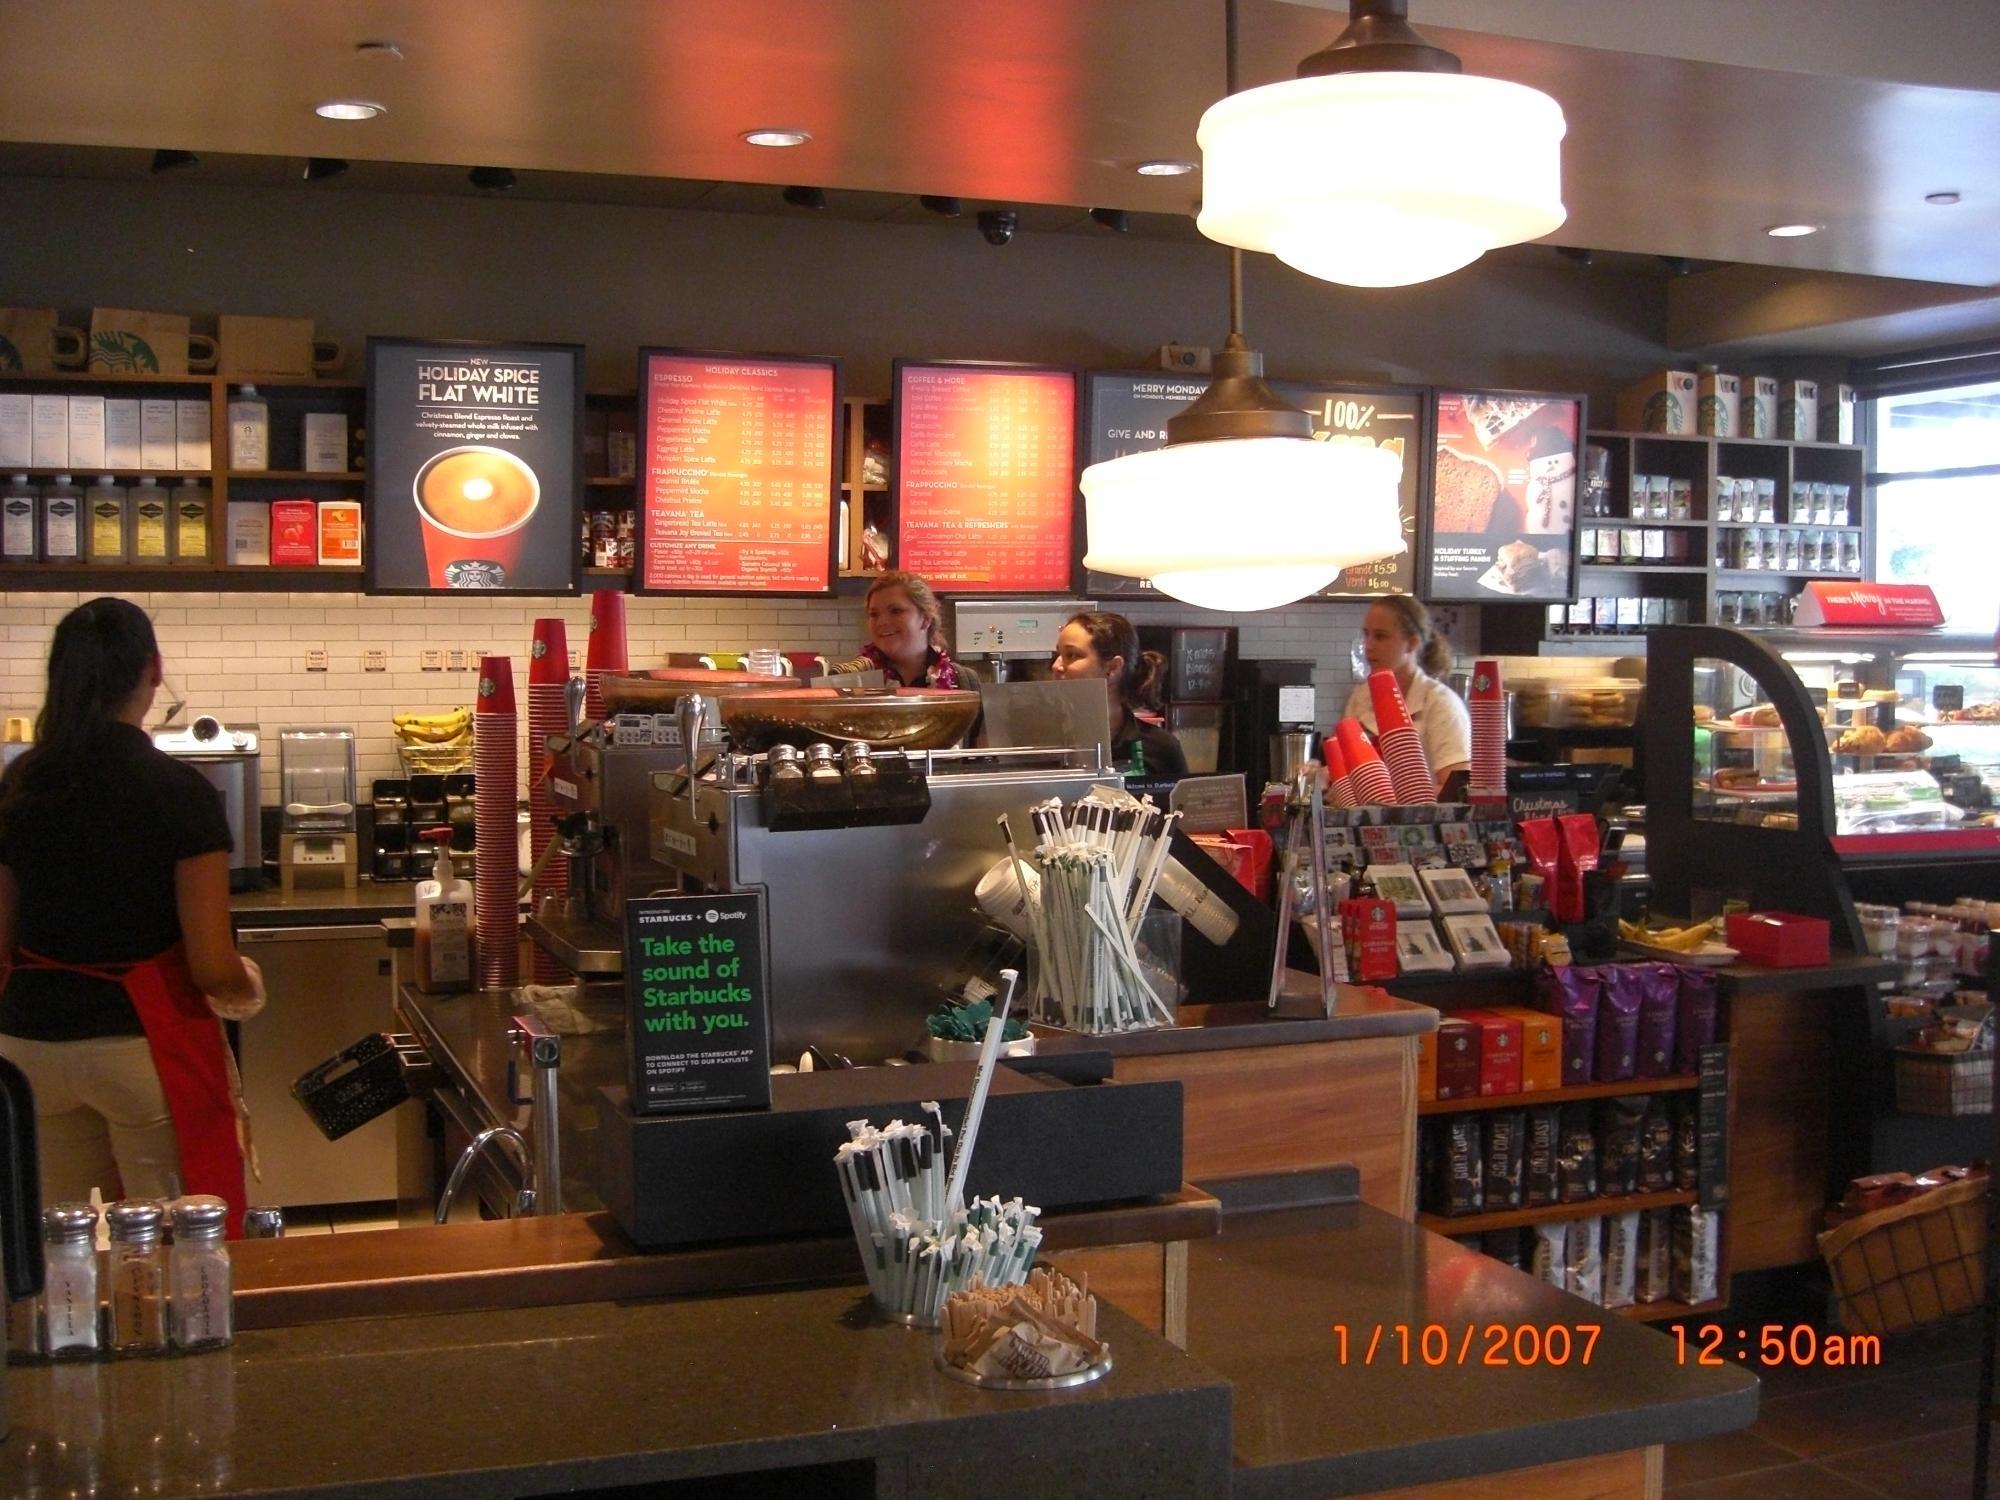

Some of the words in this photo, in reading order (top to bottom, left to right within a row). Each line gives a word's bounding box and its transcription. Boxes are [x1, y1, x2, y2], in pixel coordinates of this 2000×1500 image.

[470, 358, 488, 366] NEW
[418, 366, 490, 382] HOLIDAY
[494, 368, 540, 384] SPICE
[705, 366, 740, 376] HOLIDAY
[742, 368, 778, 377] CLASSICS
[654, 374, 693, 383] ESPRESSO
[907, 376, 936, 384] COFFEE
[944, 376, 966, 385] MORE
[418, 384, 468, 402] FLAT
[471, 385, 540, 404] WHITE
[1132, 384, 1165, 394] MERRY
[421, 411, 453, 420] Christmas
[454, 412, 473, 420] Blend
[474, 412, 502, 422] Espresso
[502, 413, 520, 421] Roast
[521, 414, 533, 422] and
[1324, 399, 1376, 431] 100%
[468, 422, 486, 430] whole
[486, 422, 500, 430] milk
[500, 423, 524, 431] infused
[525, 424, 538, 432] with
[434, 431, 466, 439] cinnamon,
[466, 432, 486, 440] ginger
[486, 432, 499, 440] and
[500, 432, 521, 440] cloves.
[1108, 428, 1131, 439] GIVE
[1134, 430, 1156, 440] AND
[652, 467, 708, 477] FRAPPUCCINO
[906, 480, 959, 489] FRAPPUCCINO
[651, 509, 688, 518] TEAVANA
[690, 510, 704, 518] TEA
[906, 521, 939, 530] TEAVANA
[942, 521, 956, 530] TEA
[650, 542, 683, 550] CUSTOMIZE
[1434, 548, 1462, 556] HOLIDAY
[1462, 548, 1486, 556] TURKEY
[1850, 592, 1886, 616] Merry
[640, 914, 693, 924] STARBUCKS
[720, 912, 747, 921] Spotify
[640, 936, 692, 956] Take
[698, 933, 736, 954] the
[642, 958, 710, 982] sound
[716, 957, 740, 978] of
[643, 982, 752, 1008] Starbucks
[645, 1010, 696, 1032] with
[702, 1013, 750, 1035] you.
[645, 1054, 686, 1062] DOWNLOAD
[686, 1052, 700, 1060] THE
[656, 1060, 688, 1068] CONNECT
[1614, 1228, 1626, 1286] ESPRESSO
